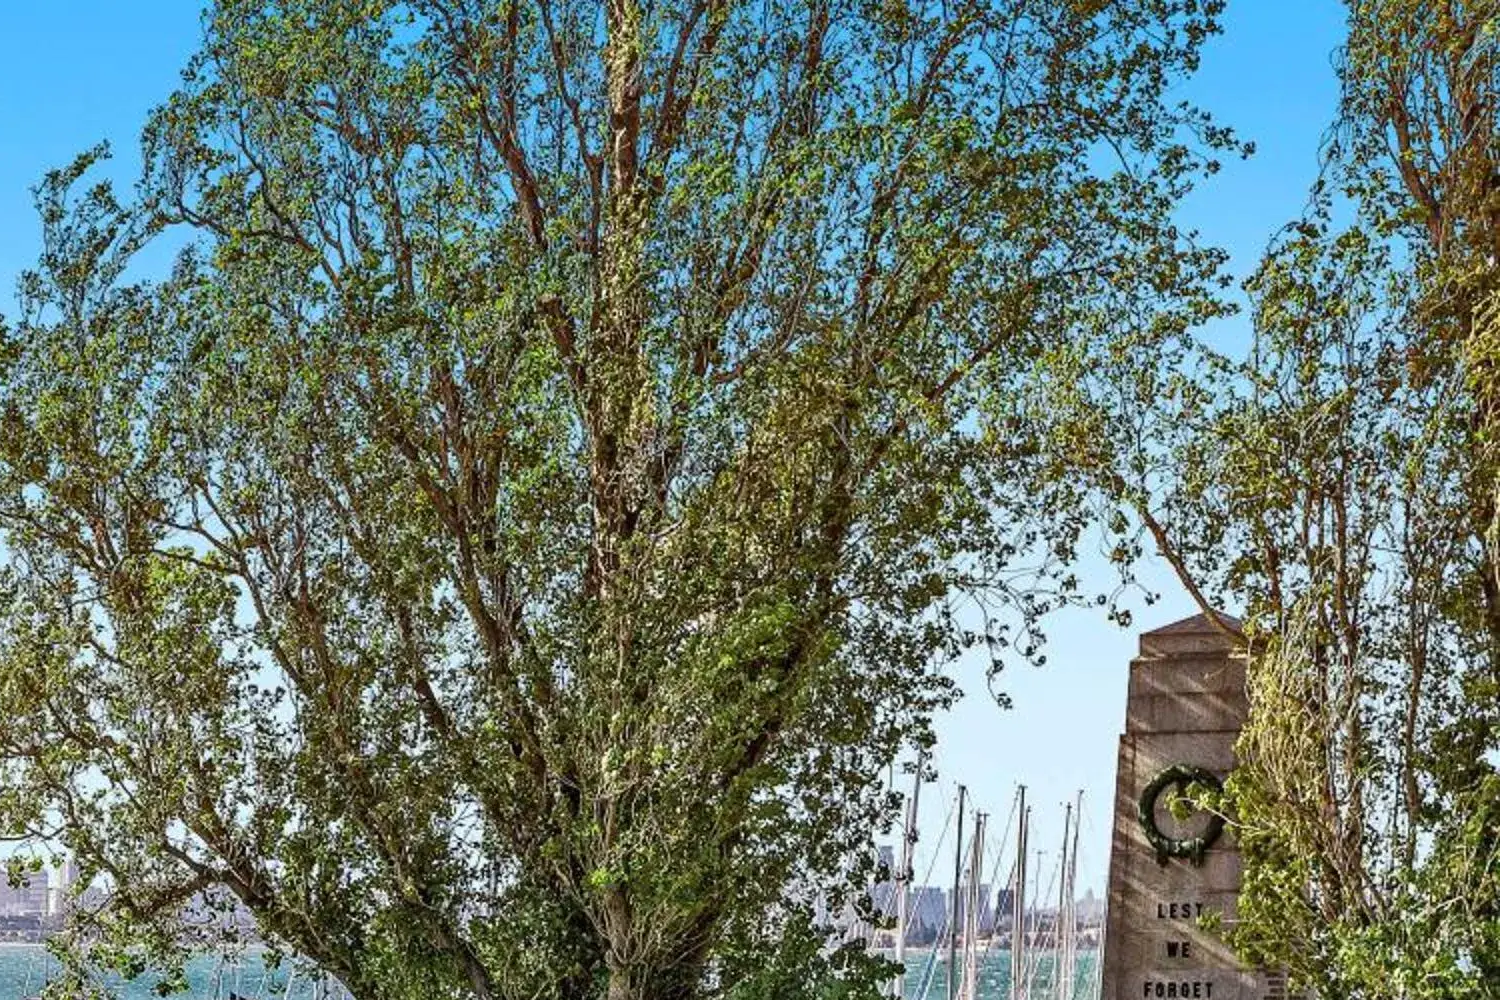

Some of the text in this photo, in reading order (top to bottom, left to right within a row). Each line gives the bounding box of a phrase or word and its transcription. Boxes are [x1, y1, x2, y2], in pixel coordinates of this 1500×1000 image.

[1157, 903, 1203, 919] LEST
[1167, 941, 1190, 959] WE
[1143, 982, 1213, 998] FORGET
